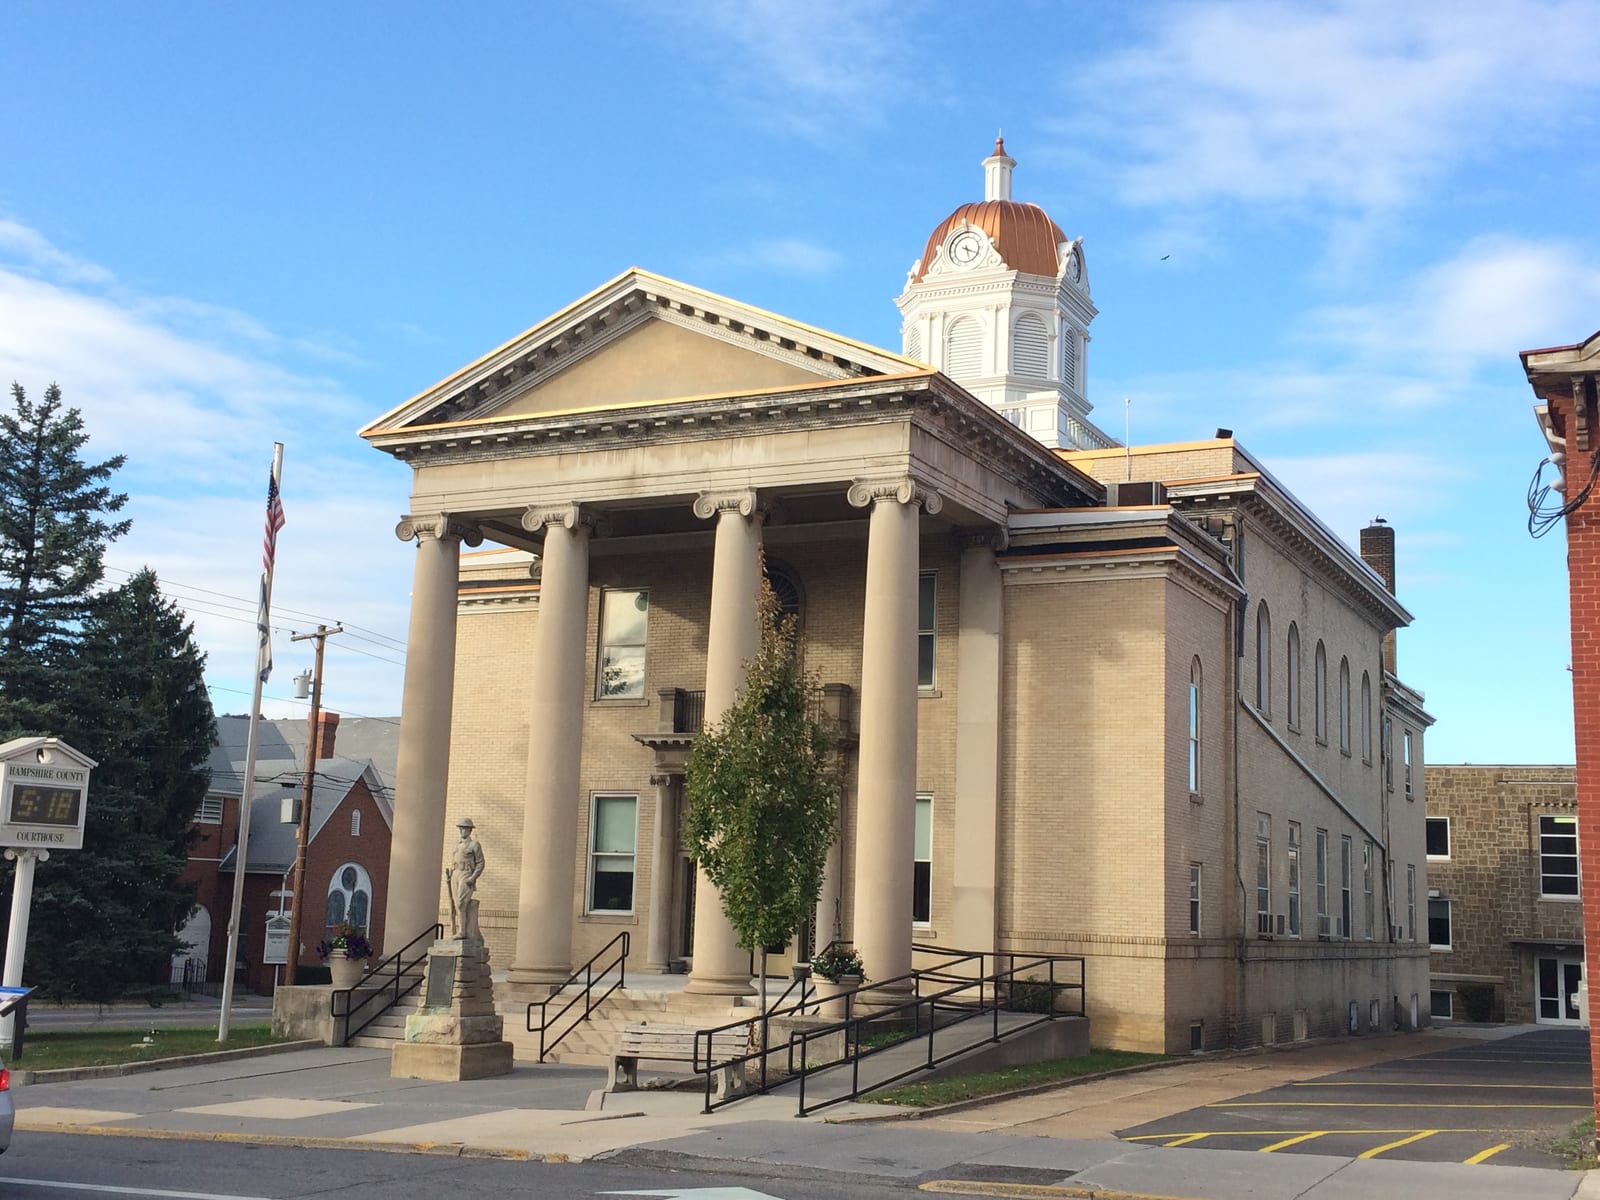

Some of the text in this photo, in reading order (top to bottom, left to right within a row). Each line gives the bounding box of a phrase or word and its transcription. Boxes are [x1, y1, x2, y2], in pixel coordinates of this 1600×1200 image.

[9, 766, 84, 781] HAMPSHIRE COUNTY
[17, 789, 74, 818] 5:18
[17, 832, 64, 842] COURTHOUSE
